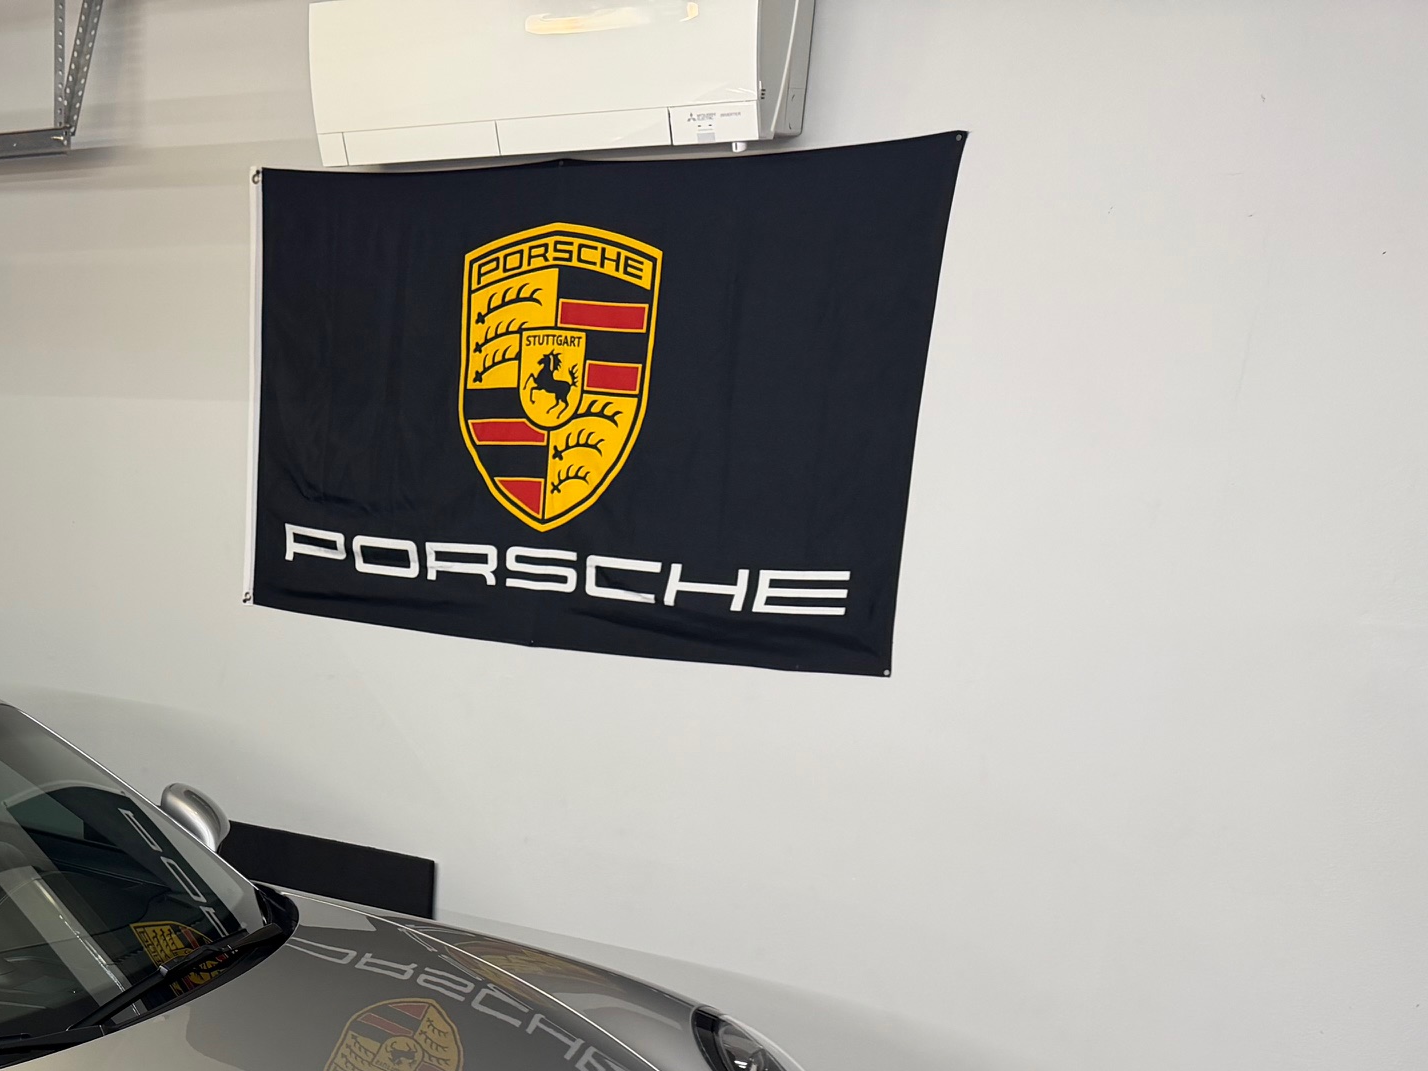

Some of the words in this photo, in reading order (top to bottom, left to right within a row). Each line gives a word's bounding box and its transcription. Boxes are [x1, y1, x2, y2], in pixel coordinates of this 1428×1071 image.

[476, 240, 645, 286] PORSCHE
[525, 334, 582, 348] STUTTGART
[284, 522, 851, 616] PORSCHE
